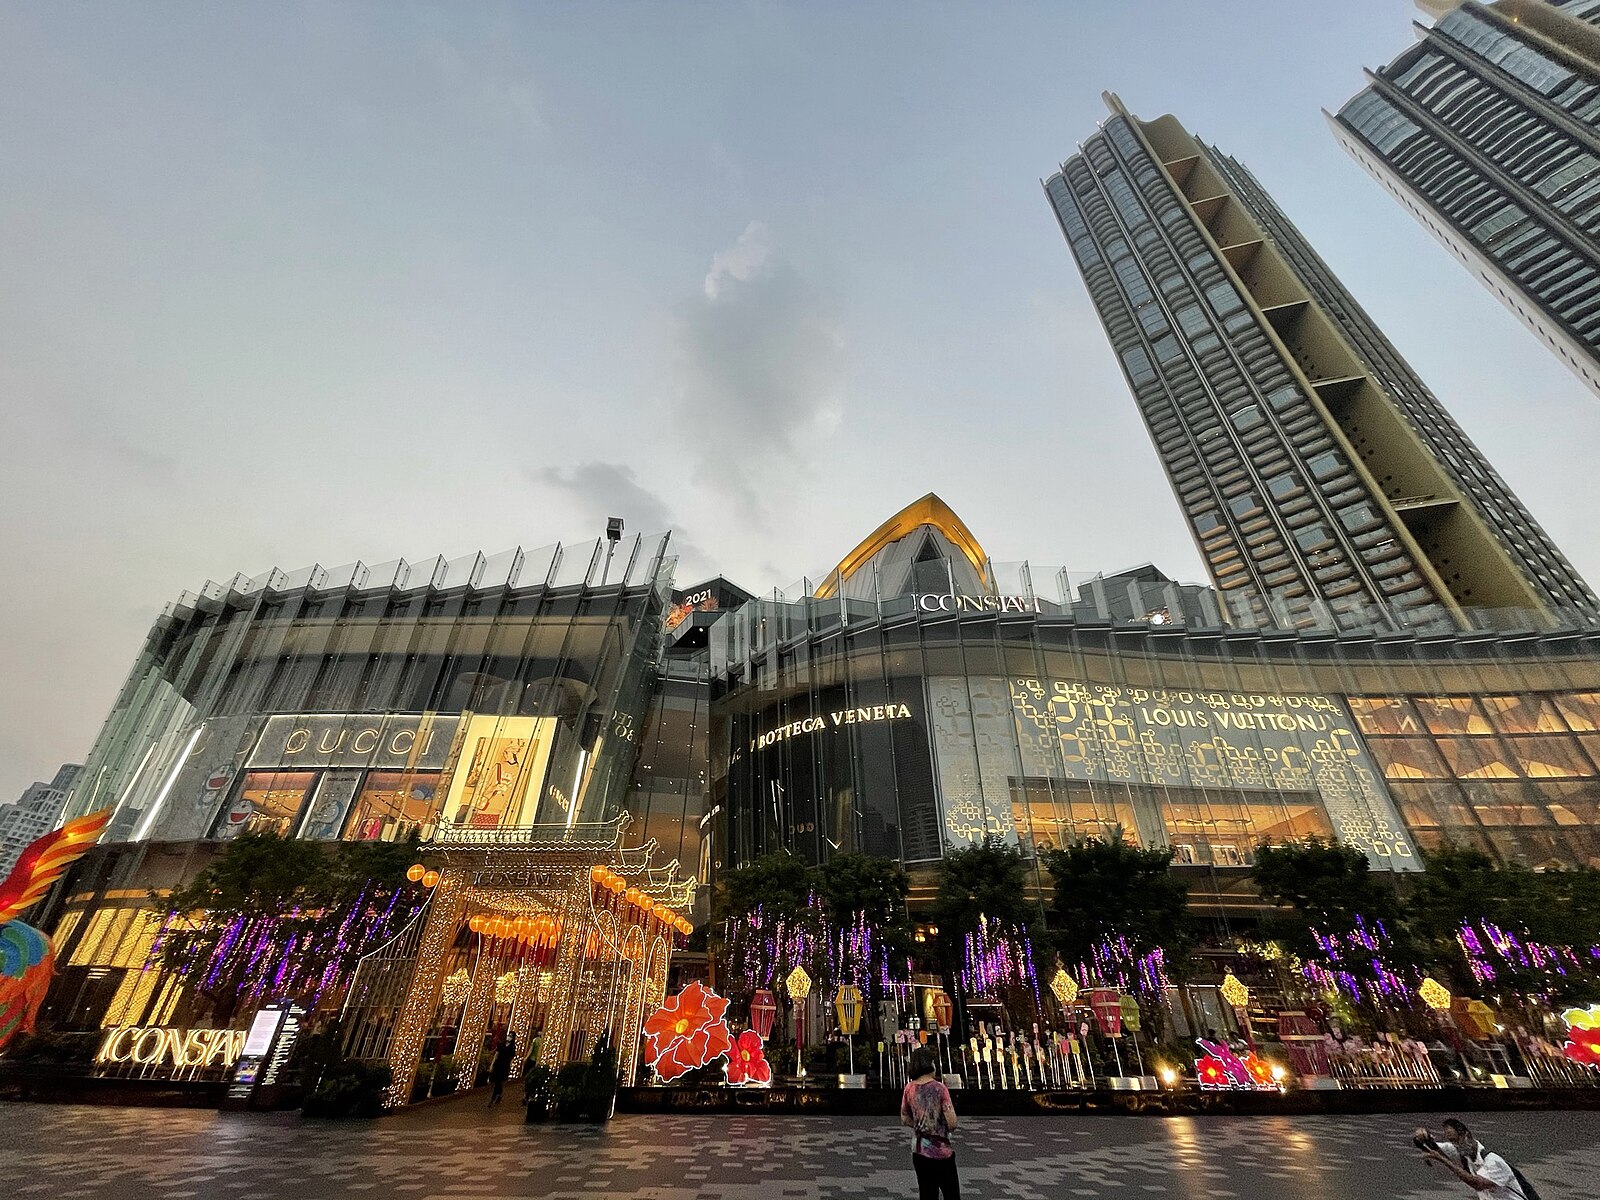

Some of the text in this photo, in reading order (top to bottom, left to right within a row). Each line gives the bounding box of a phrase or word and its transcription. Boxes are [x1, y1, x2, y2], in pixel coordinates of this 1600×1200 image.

[685, 589, 712, 606] 2021
[758, 703, 912, 749] BOTTEGA VENETA
[1142, 707, 1319, 732] LOUIS VUITTON
[285, 728, 435, 755] GUCCI
[473, 870, 551, 886] ICONSIAM
[96, 1027, 247, 1067] ICONSIAM
